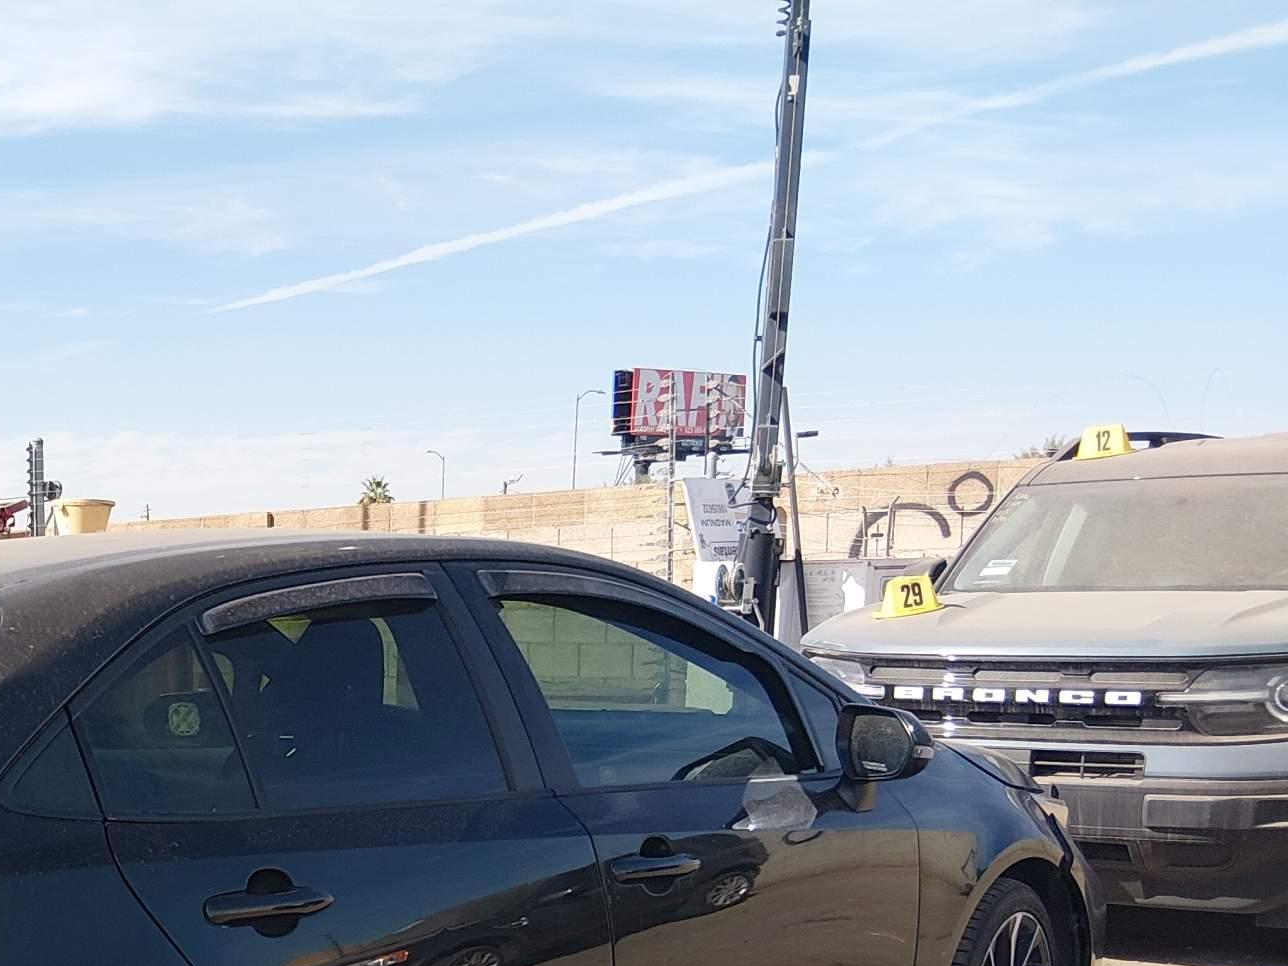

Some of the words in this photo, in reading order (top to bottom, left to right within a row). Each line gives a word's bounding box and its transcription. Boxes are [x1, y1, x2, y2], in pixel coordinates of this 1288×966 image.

[1096, 430, 1111, 452] 12
[900, 582, 924, 608] 29
[893, 686, 1142, 705] BRONCO
